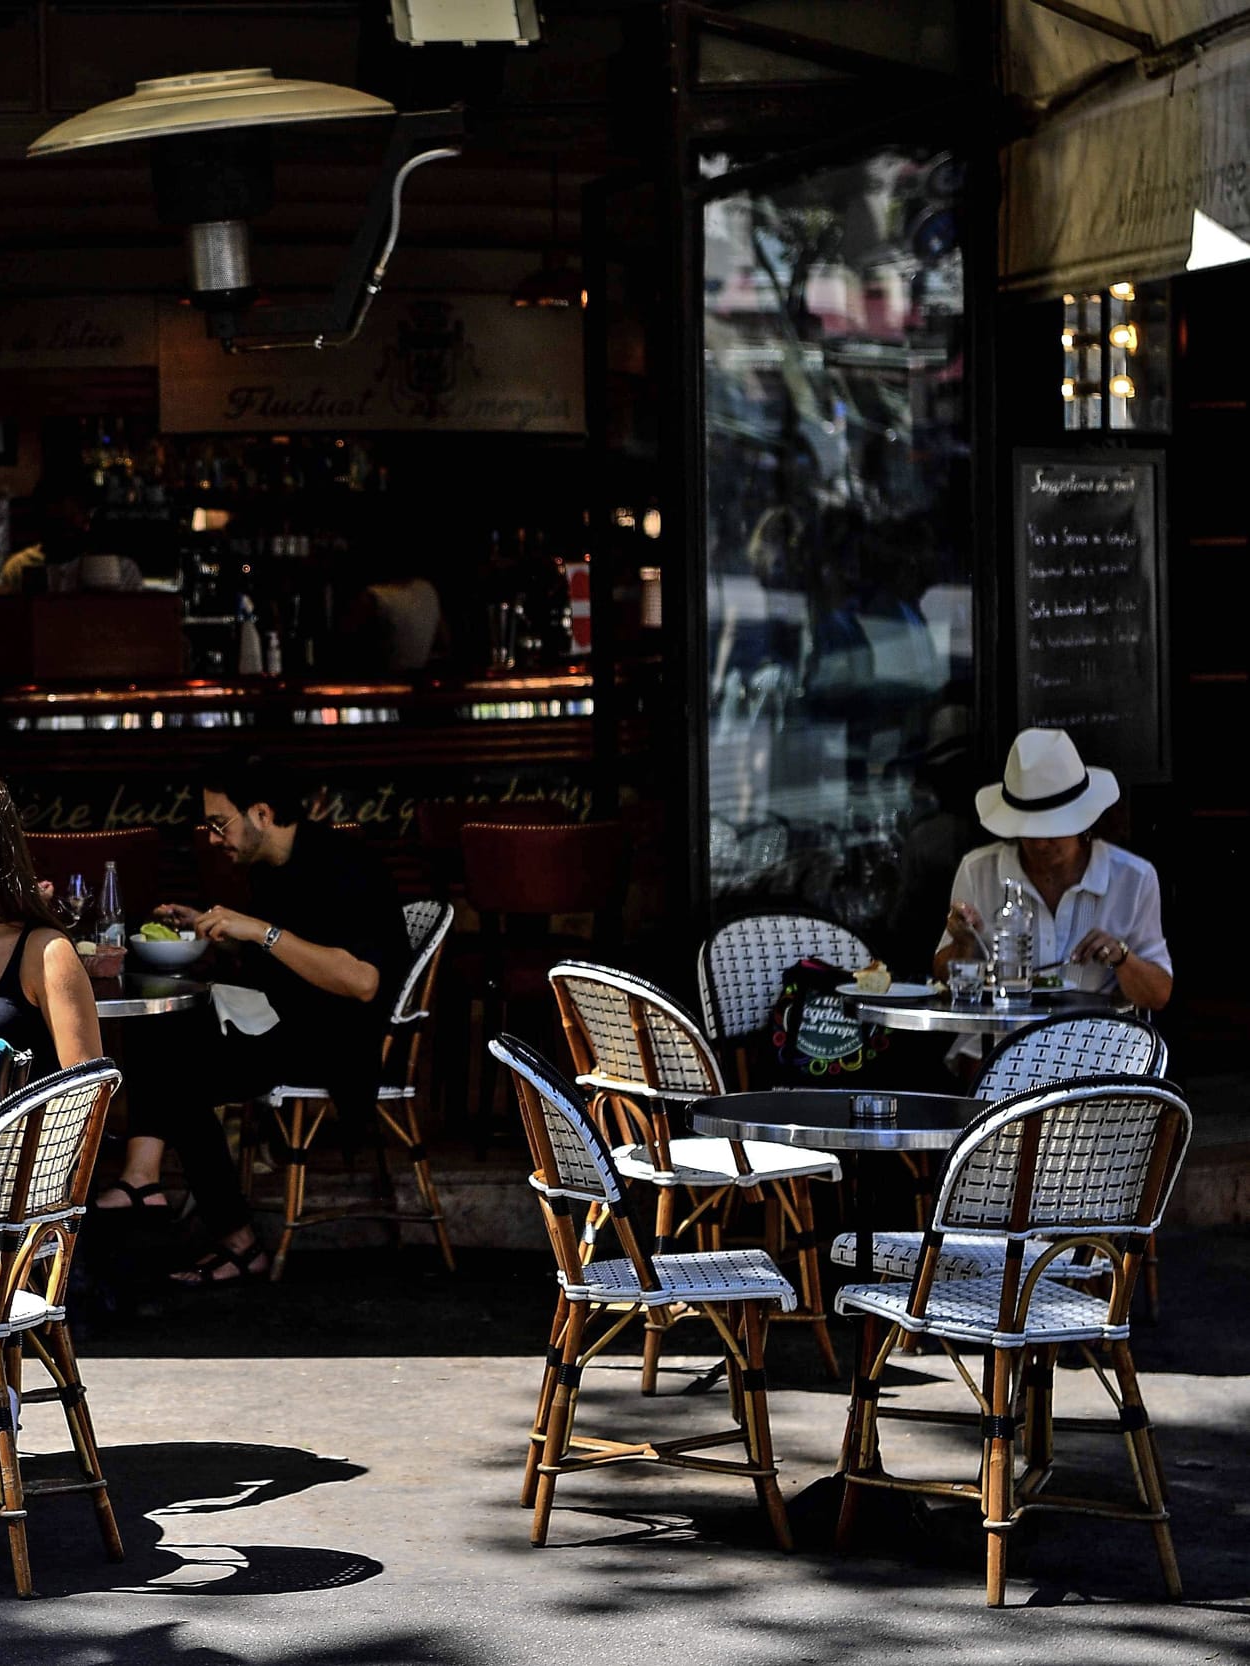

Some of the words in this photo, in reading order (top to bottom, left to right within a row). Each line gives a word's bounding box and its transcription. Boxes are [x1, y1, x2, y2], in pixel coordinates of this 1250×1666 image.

[223, 384, 375, 421] Fluctuat
[102, 783, 193, 833] fait
[818, 1022, 859, 1039] Europe
